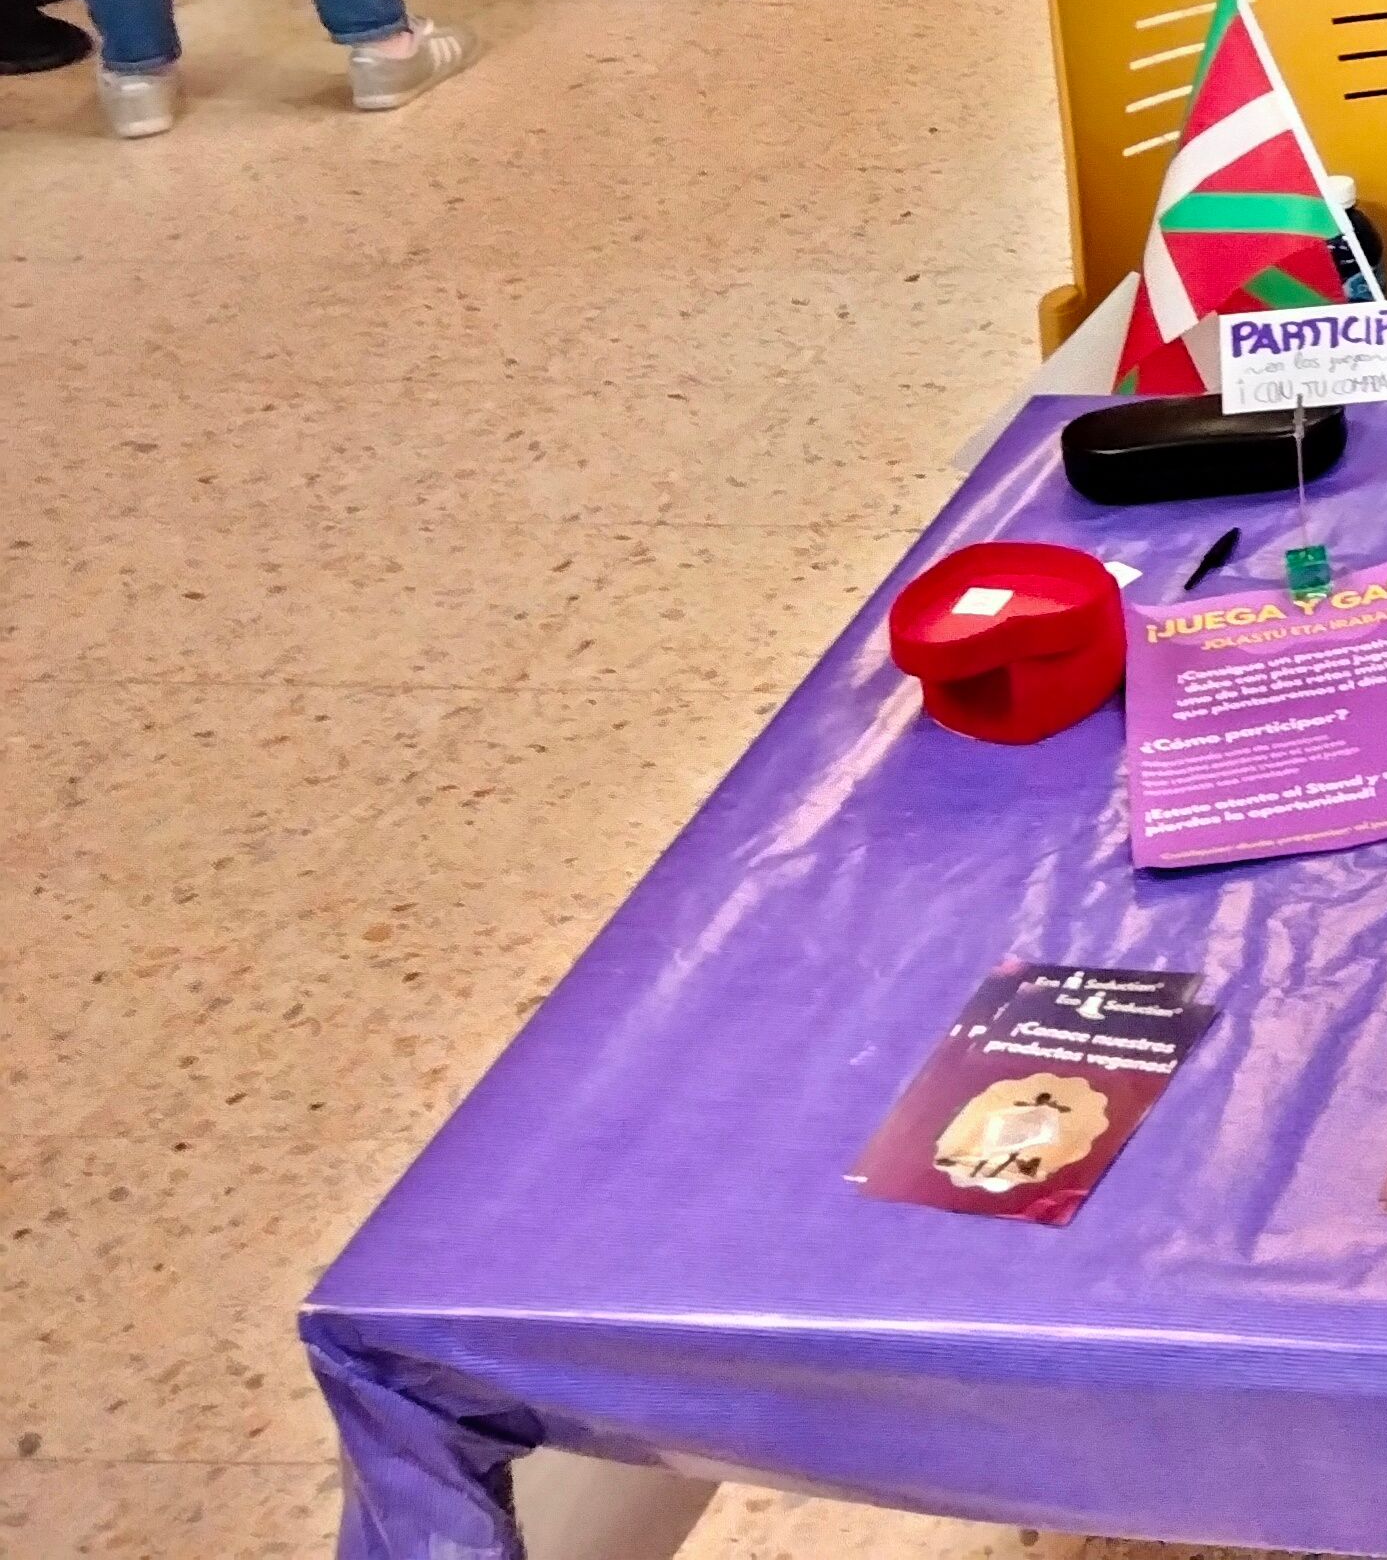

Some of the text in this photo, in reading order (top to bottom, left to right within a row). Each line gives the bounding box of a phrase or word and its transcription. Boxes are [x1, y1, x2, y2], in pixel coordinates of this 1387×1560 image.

[1146, 603, 1288, 644] ¡JUEGA
[1293, 599, 1320, 616] Y
[1290, 623, 1327, 636] ETA
[1139, 707, 1351, 755] ¿Cómo participar?
[1305, 774, 1364, 795] Stand
[1247, 787, 1377, 819] oportunidad!
[1010, 1021, 1091, 1043] ¡Conoce
[1091, 1034, 1177, 1054] nuestros
[983, 1040, 1178, 1074] productos veganos!
